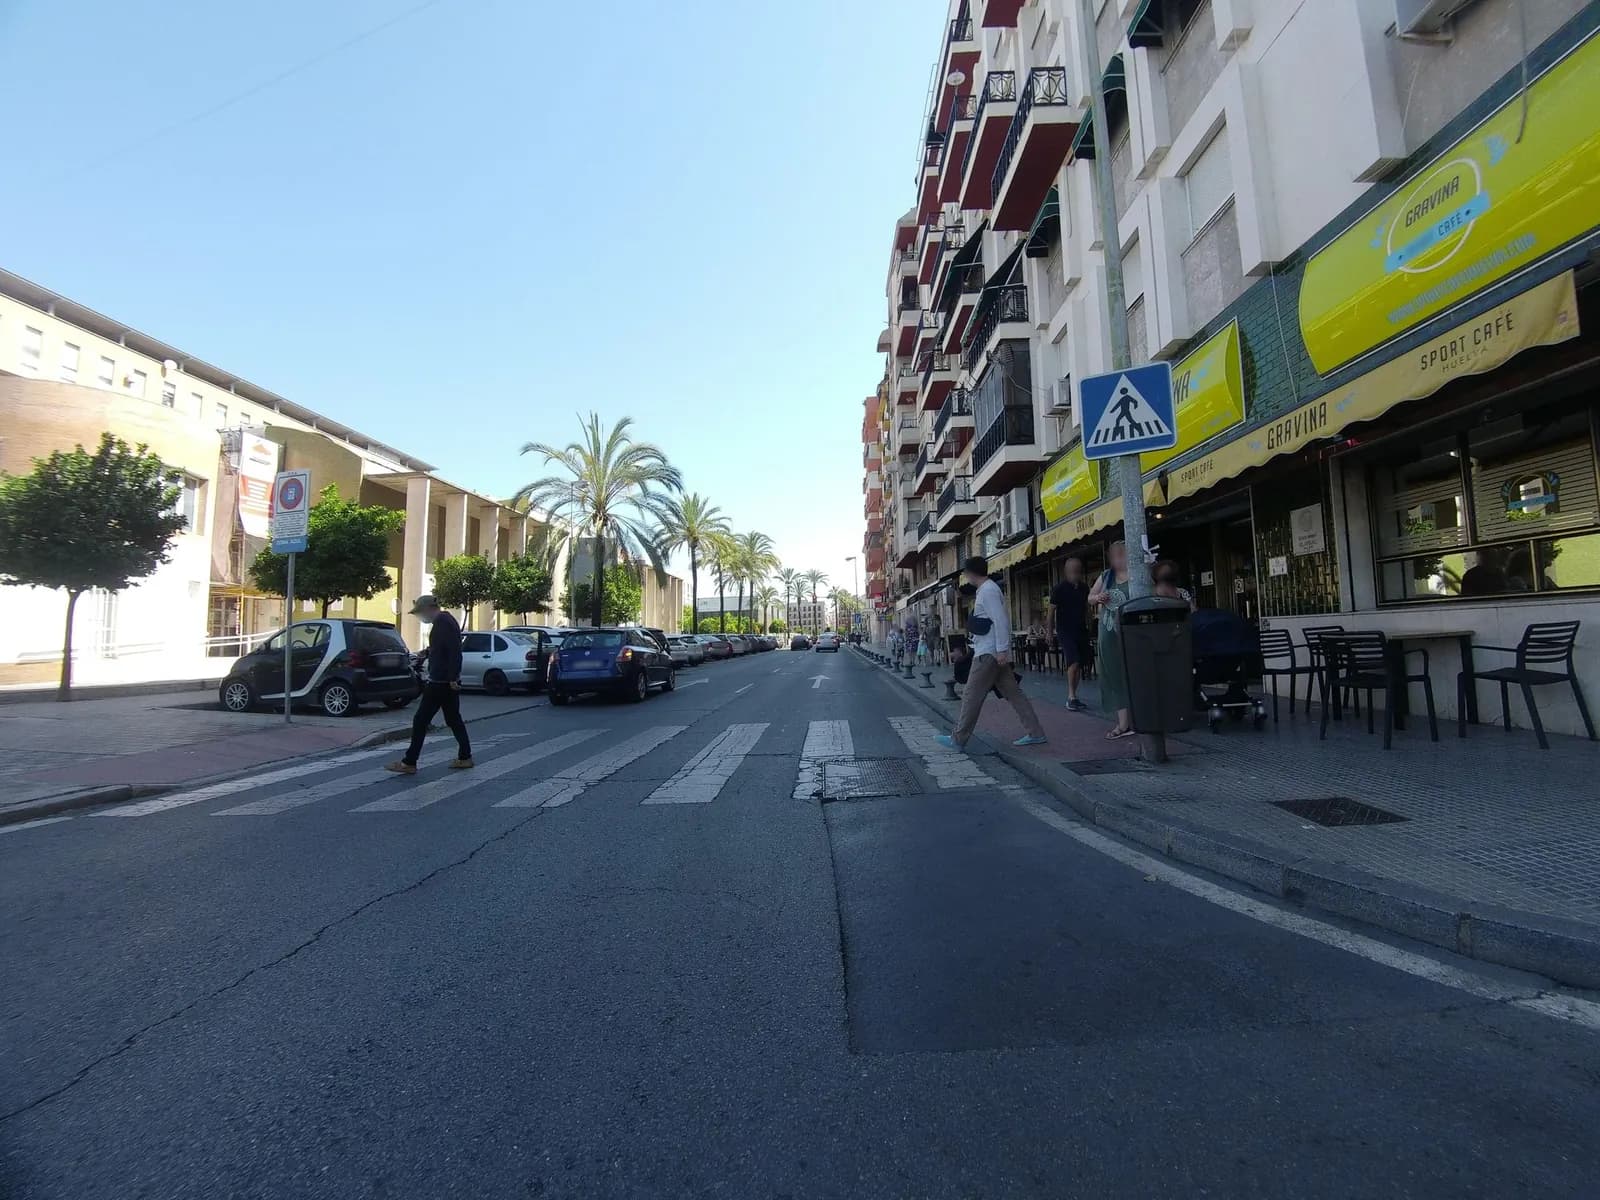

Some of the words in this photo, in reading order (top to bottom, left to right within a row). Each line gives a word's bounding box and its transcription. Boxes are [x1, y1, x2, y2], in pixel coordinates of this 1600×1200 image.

[1406, 176, 1459, 228] GRAVINA
[1421, 336, 1465, 370] SPORT
[1267, 401, 1327, 450] GRAVINA
